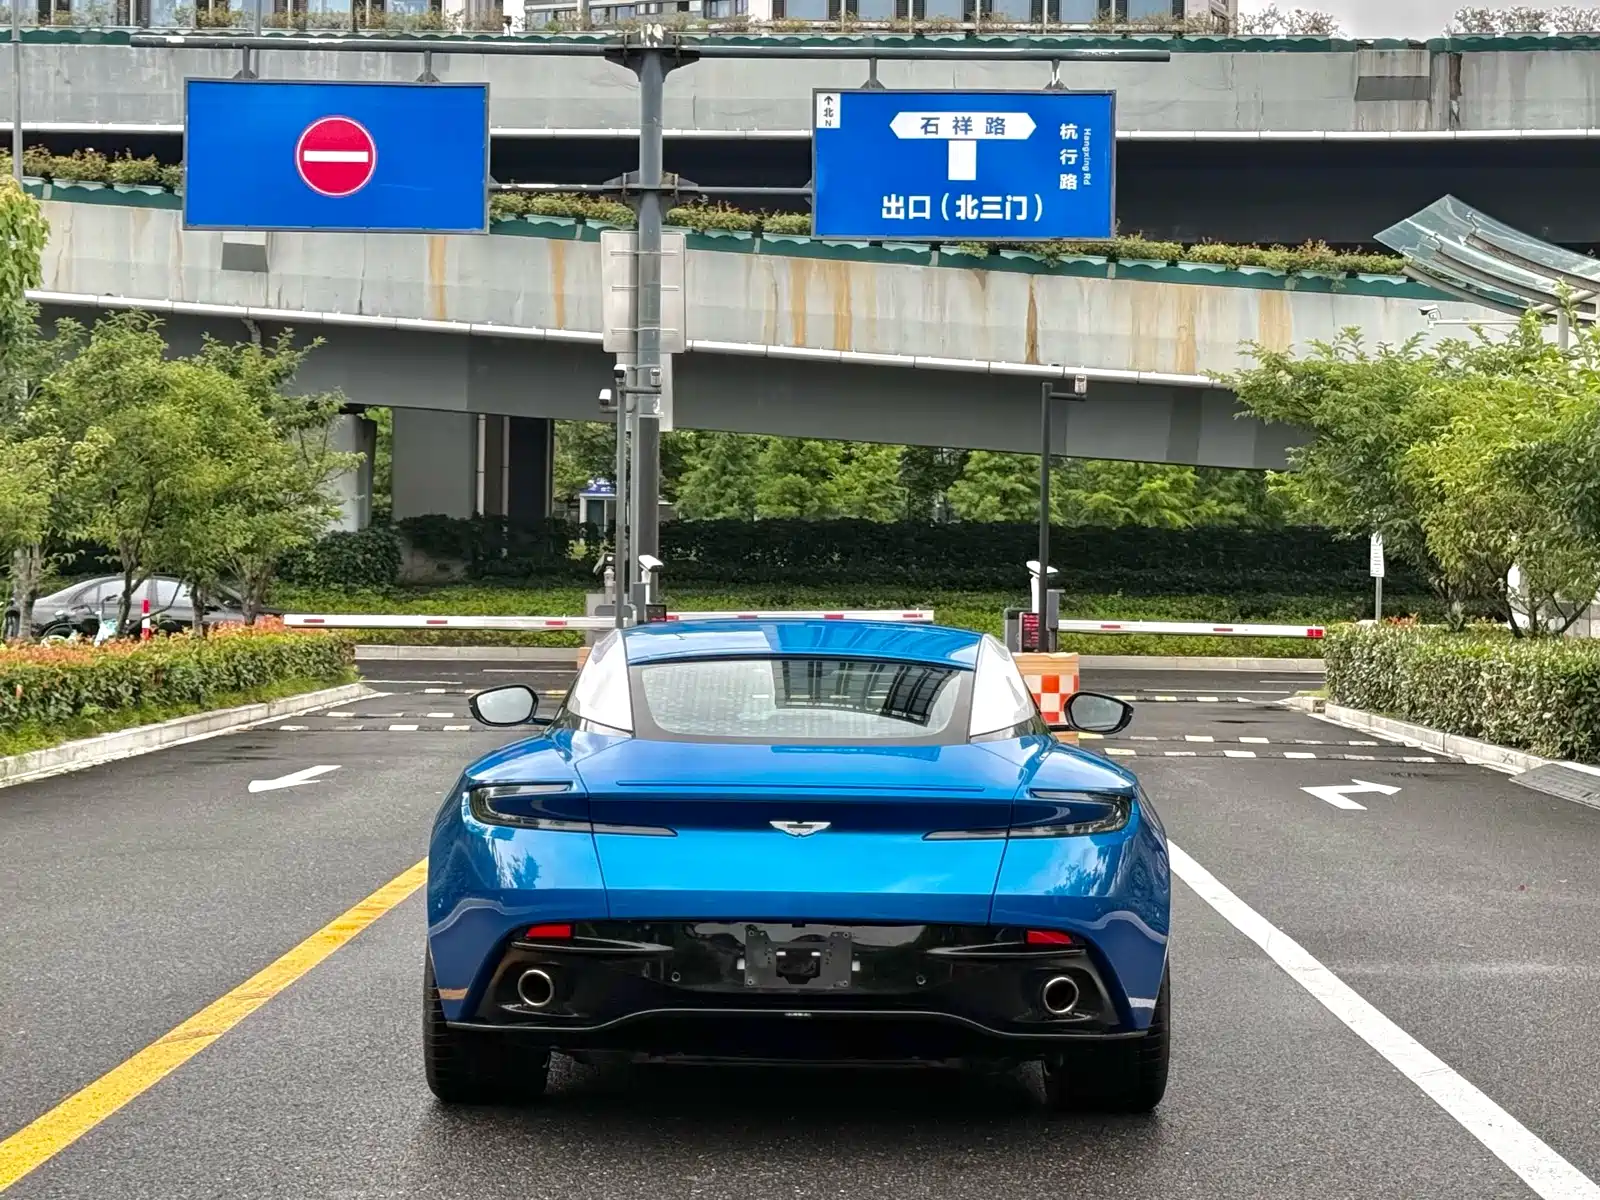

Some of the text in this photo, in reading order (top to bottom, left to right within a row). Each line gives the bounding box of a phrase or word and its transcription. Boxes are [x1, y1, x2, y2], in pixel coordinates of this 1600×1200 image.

[822, 107, 834, 118] 北
[825, 119, 832, 127] N
[920, 116, 1006, 136] 石祥路
[1059, 123, 1078, 190] 杭行路
[1082, 128, 1092, 185] Hangxing Rd
